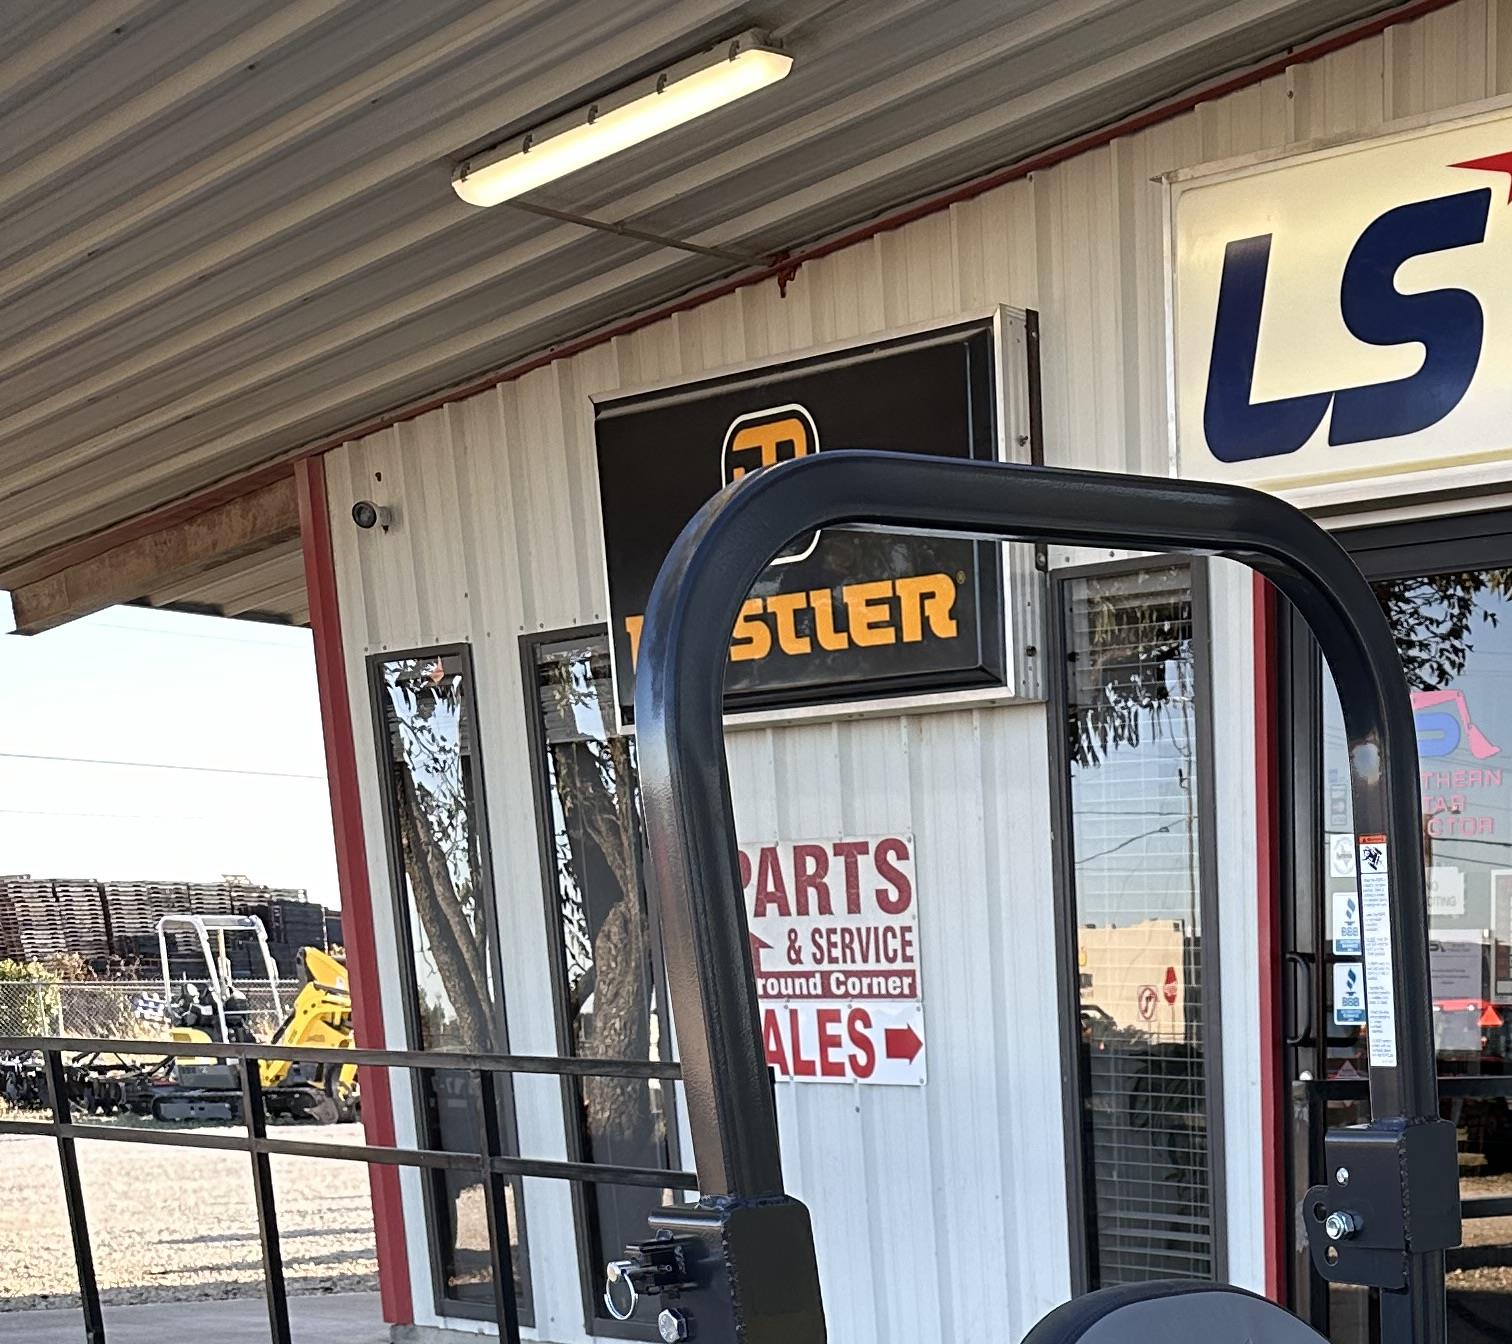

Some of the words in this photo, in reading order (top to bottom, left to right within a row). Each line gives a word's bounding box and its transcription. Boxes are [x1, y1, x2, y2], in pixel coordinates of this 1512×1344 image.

[1204, 187, 1492, 463] LS
[625, 573, 958, 673] STLER
[786, 927, 804, 965] &
[810, 925, 914, 965] SERVICE
[757, 973, 822, 996] round
[830, 972, 912, 996] Corner
[762, 1007, 876, 1079] ALES
